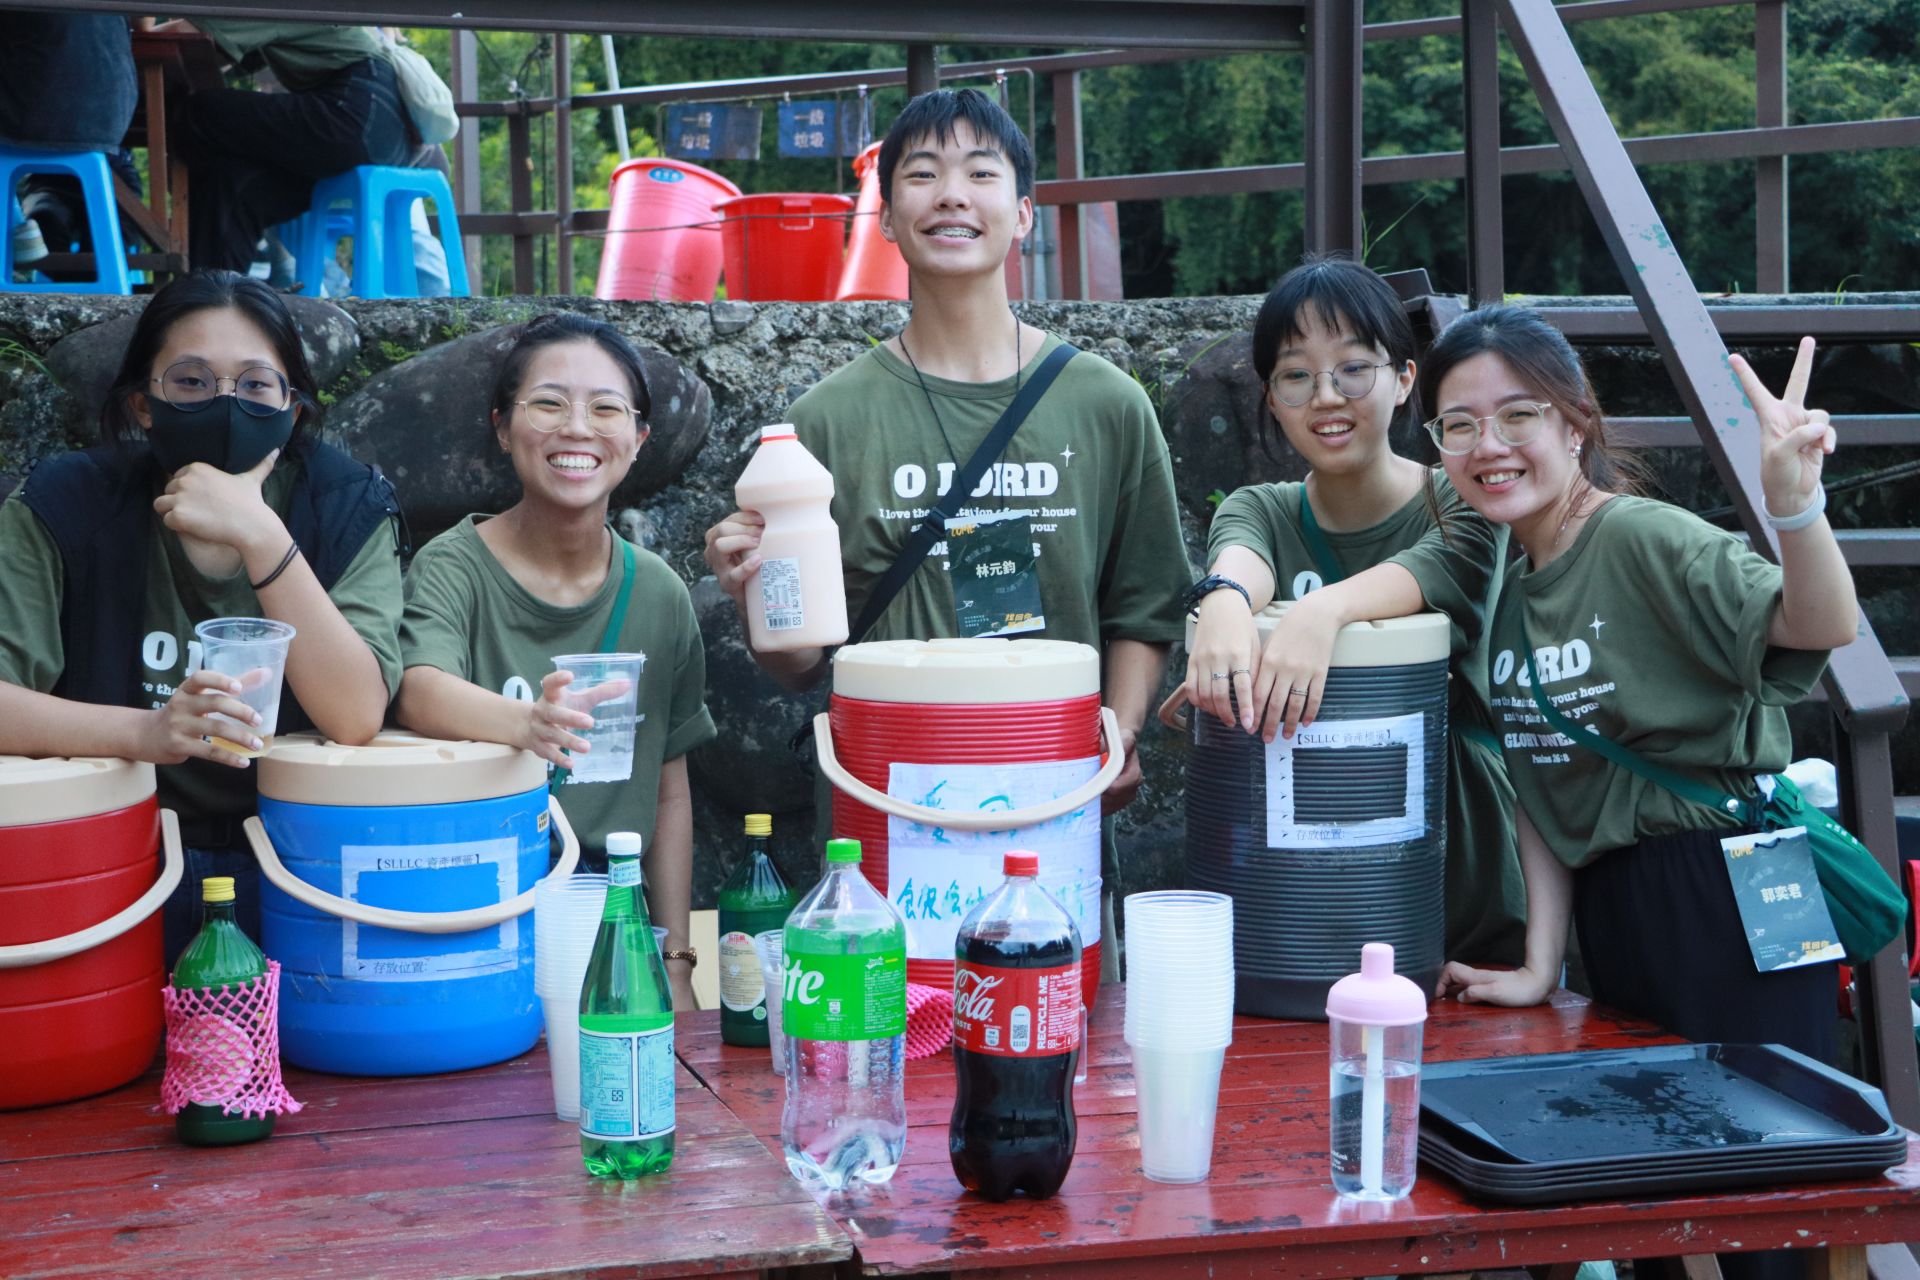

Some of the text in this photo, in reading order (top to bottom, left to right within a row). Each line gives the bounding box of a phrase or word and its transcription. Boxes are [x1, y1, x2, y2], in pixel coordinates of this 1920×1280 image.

[893, 463, 927, 499] O
[886, 509, 911, 519] love
[1041, 507, 1077, 517] house
[1030, 523, 1058, 534] your
[142, 630, 178, 671] O
[1493, 638, 1591, 688] O LRD
[1551, 691, 1578, 708] your
[1579, 682, 1616, 698] house
[1504, 733, 1539, 748] GLORY
[1037, 975, 1049, 1050] RECYCLE ME
